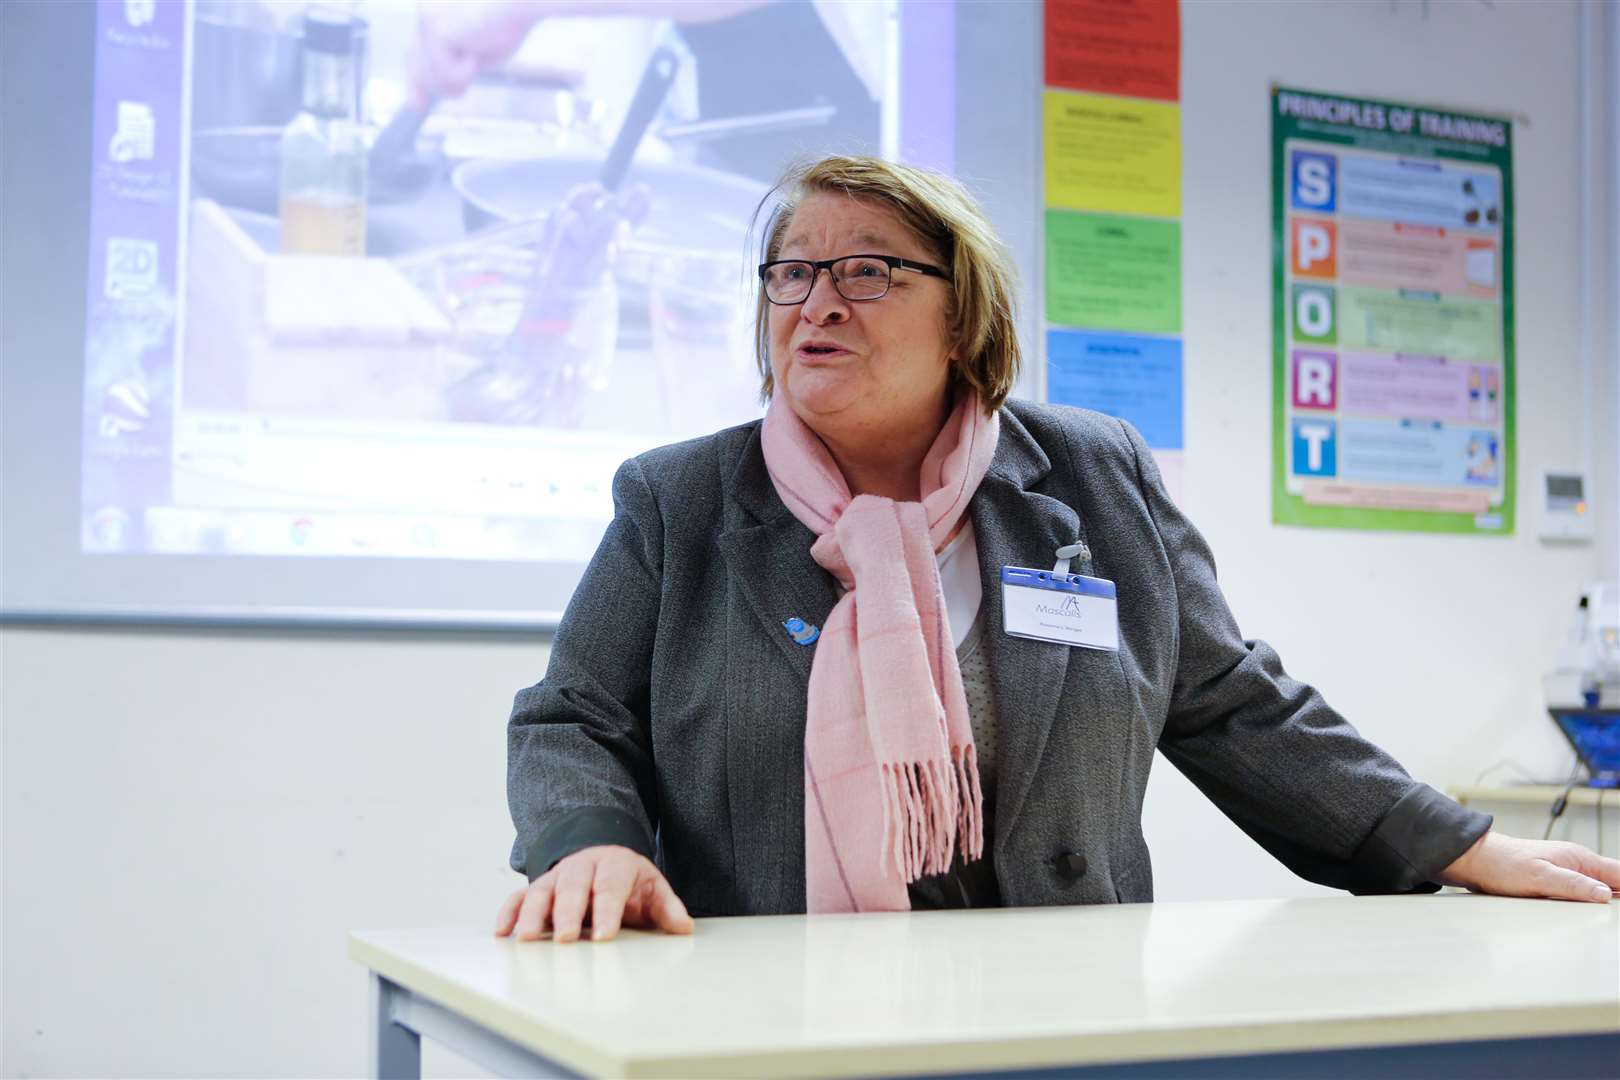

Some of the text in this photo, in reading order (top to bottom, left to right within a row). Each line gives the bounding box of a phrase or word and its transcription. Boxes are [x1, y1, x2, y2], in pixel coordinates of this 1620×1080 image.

[1278, 91, 1387, 130] PRINCIPLES
[1389, 108, 1415, 132] OF
[1419, 110, 1505, 145] TRAINING
